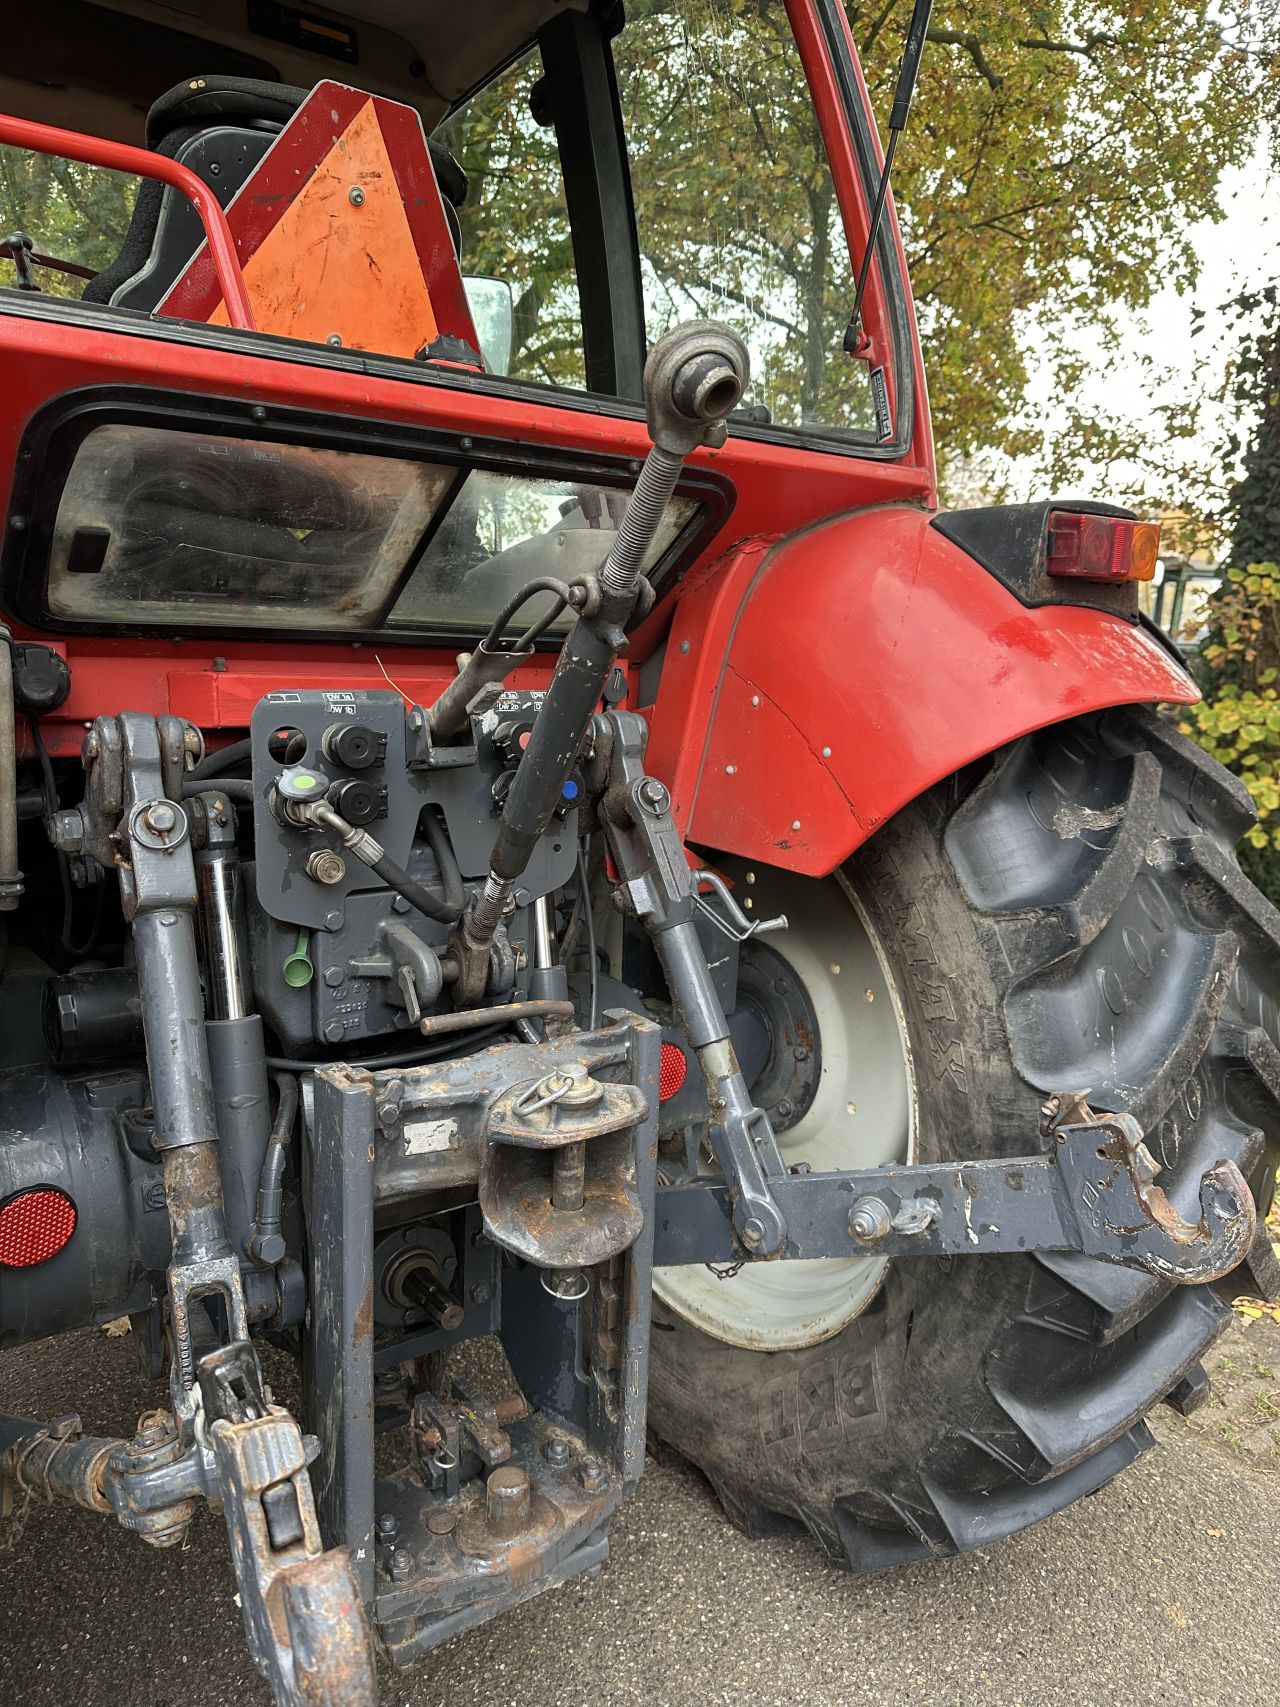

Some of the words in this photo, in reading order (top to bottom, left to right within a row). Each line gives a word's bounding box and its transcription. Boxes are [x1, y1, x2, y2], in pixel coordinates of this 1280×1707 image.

[345, 706, 353, 714] 1b
[863, 849, 969, 1096] IMAX
[763, 1360, 880, 1446] BKT
